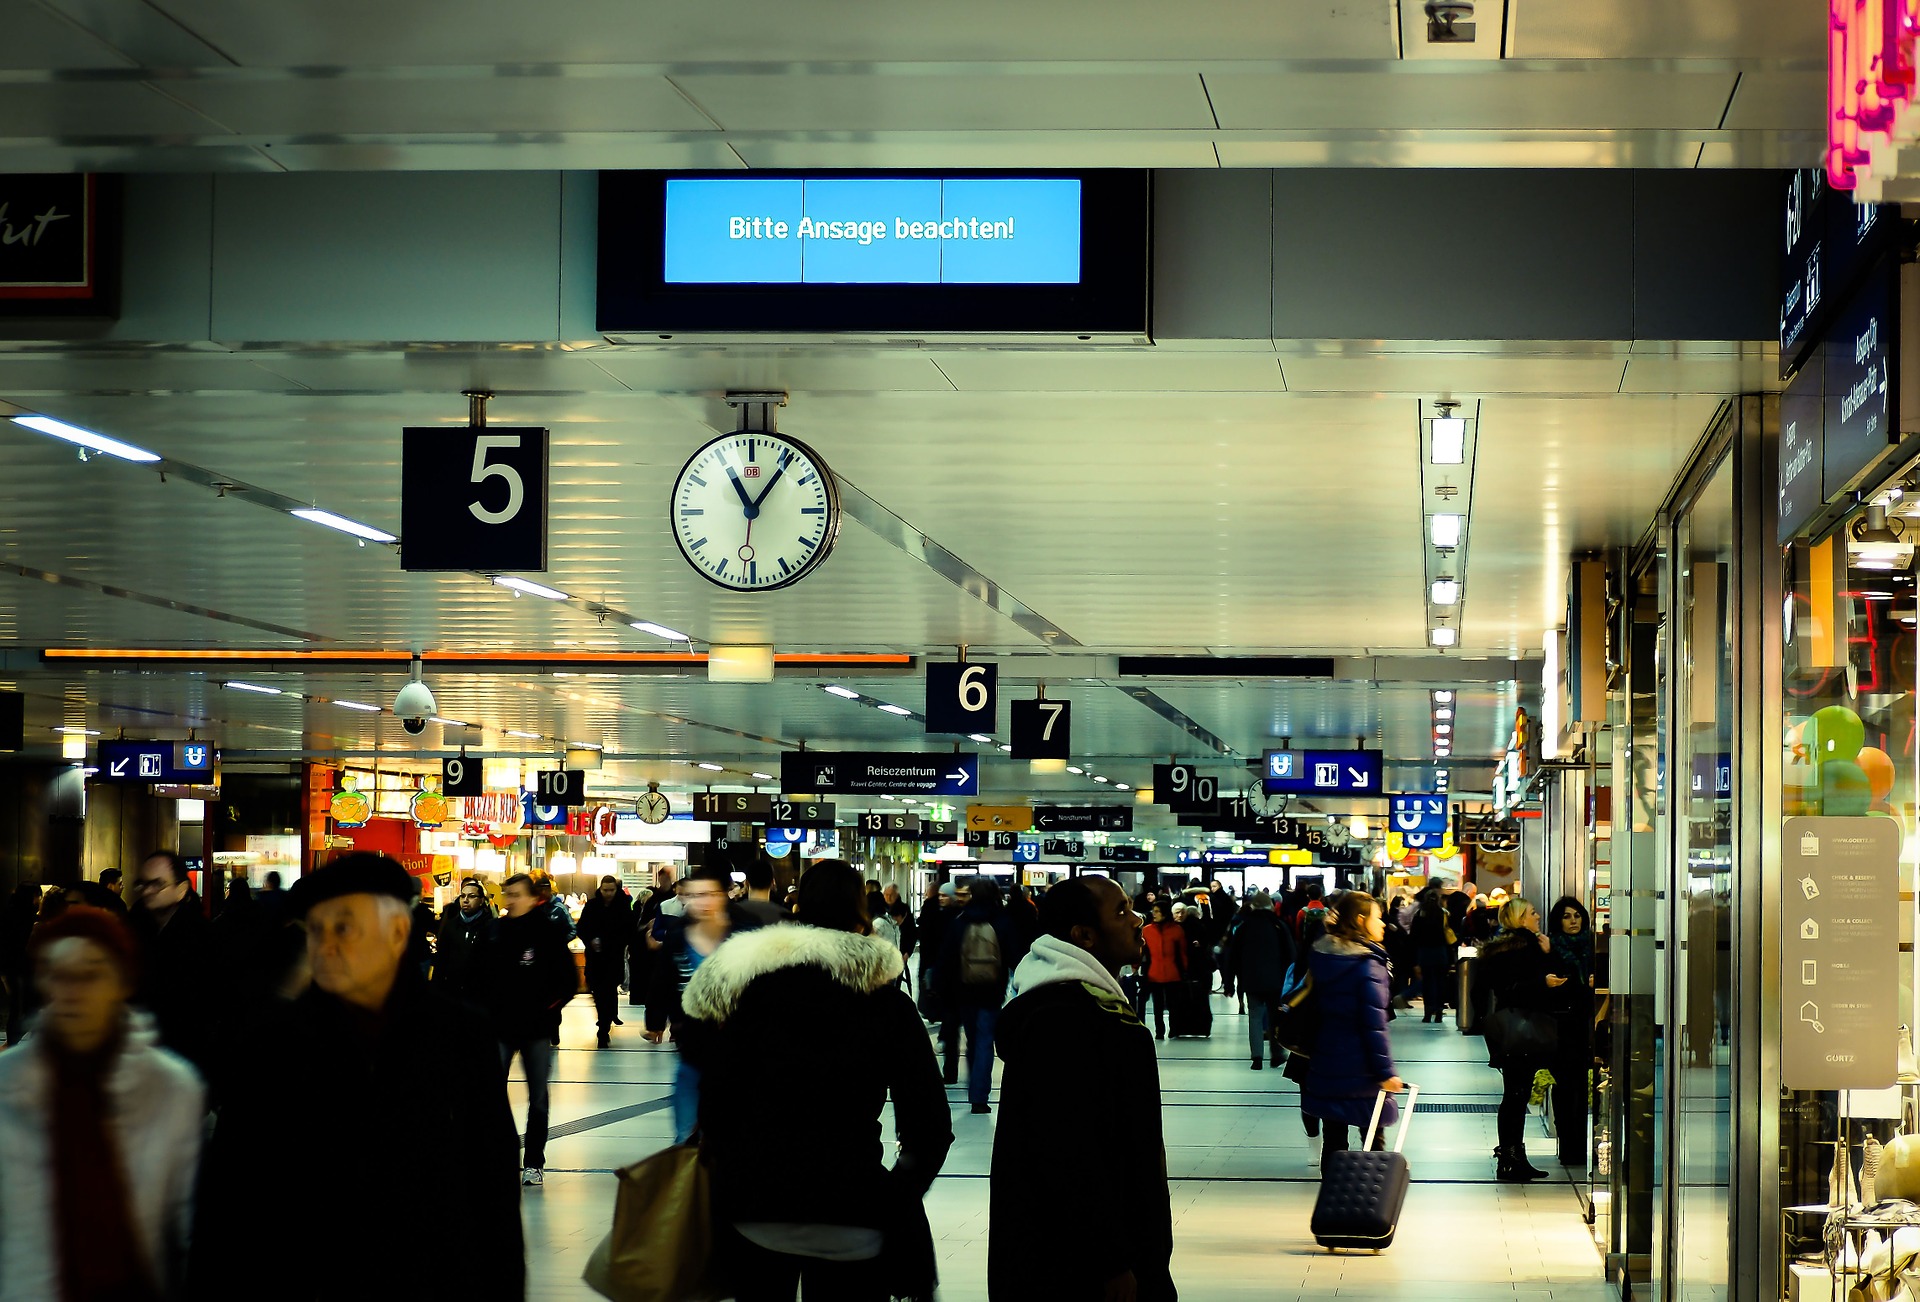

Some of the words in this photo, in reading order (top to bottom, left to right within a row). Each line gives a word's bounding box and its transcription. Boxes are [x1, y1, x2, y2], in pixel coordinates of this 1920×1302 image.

[729, 217, 788, 239] Bitte
[798, 217, 887, 245] Ansage
[895, 217, 1014, 239] beachten!
[468, 435, 524, 524] 5
[745, 468, 759, 477] DB
[958, 666, 988, 712] 6
[1039, 703, 1064, 741] 7
[447, 760, 464, 785] 9
[867, 766, 936, 776] Reisezentrum
[541, 771, 568, 795] 10
[1171, 767, 1188, 792] 9
[464, 793, 498, 822] BREZEL
[702, 794, 719, 813] 11
[736, 797, 747, 810] S
[1230, 799, 1247, 817] 11
[773, 804, 792, 820] 12
[807, 806, 818, 818] S
[865, 815, 882, 830] 13
[895, 818, 905, 828] S
[936, 823, 944, 832] S
[1272, 819, 1289, 834] 13
[716, 837, 728, 850] 16
[967, 831, 980, 841] 15
[997, 833, 1010, 845] 16
[1306, 832, 1321, 845] 15
[1046, 840, 1057, 850] 17
[1066, 842, 1078, 852] 18
[1103, 848, 1114, 856] 19
[1807, 886, 1817, 896] R
